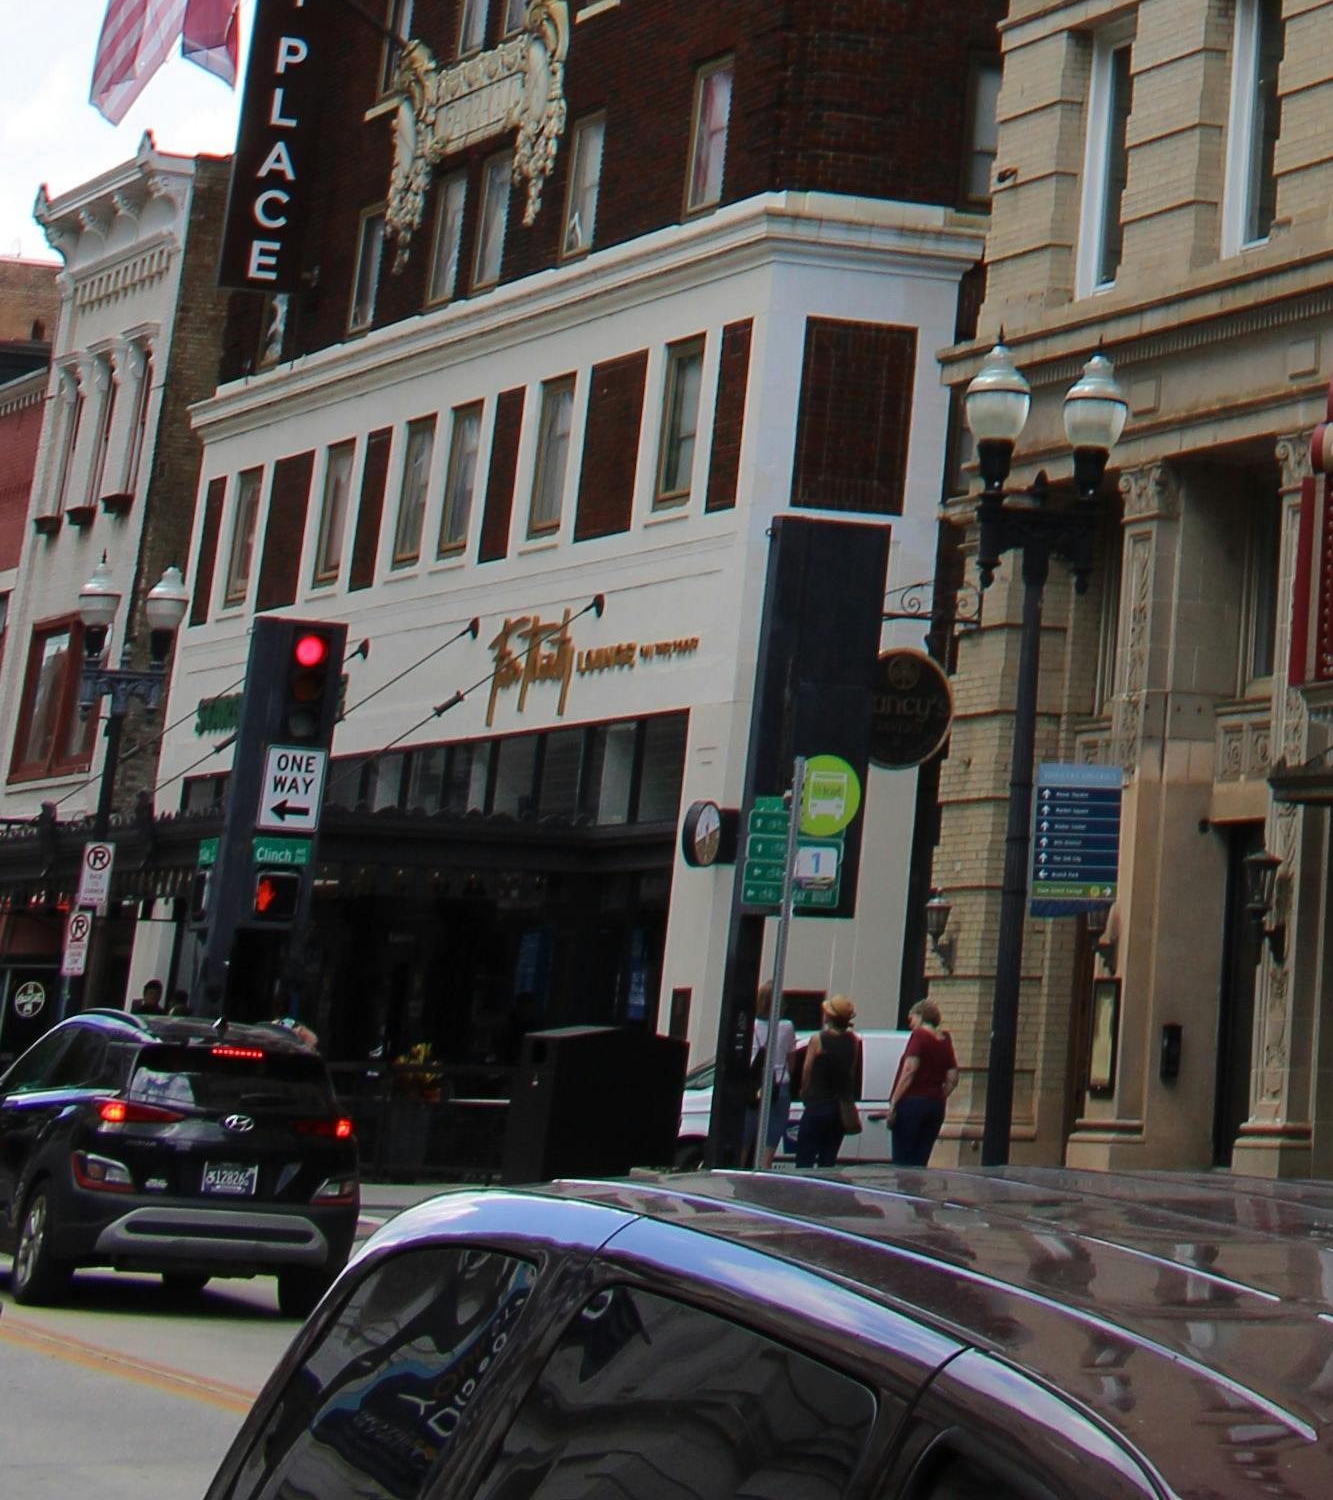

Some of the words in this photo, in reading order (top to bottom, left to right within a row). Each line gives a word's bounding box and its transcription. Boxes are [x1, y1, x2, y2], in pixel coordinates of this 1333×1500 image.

[246, 37, 309, 281] PLACE
[277, 754, 316, 773] ONE
[273, 776, 315, 795] WAY
[256, 847, 292, 862] Clinch
[810, 851, 822, 874] 1
